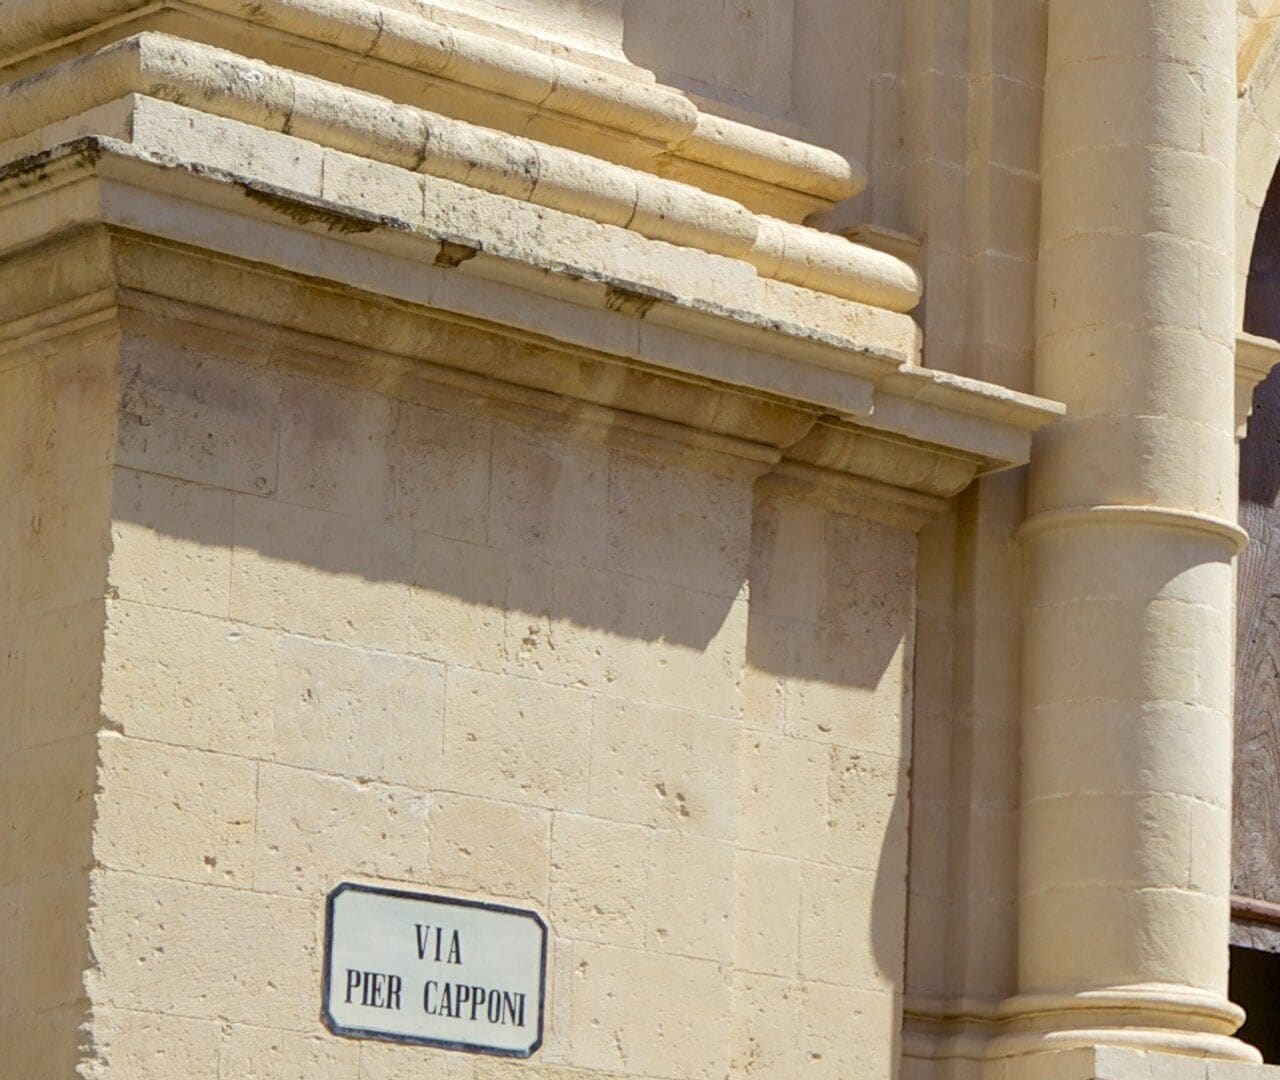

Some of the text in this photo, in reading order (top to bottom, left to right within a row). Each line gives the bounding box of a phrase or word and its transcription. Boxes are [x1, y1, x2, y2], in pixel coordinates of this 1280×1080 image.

[415, 923, 462, 965] VIA
[344, 968, 526, 1027] PIER CAPPONI
